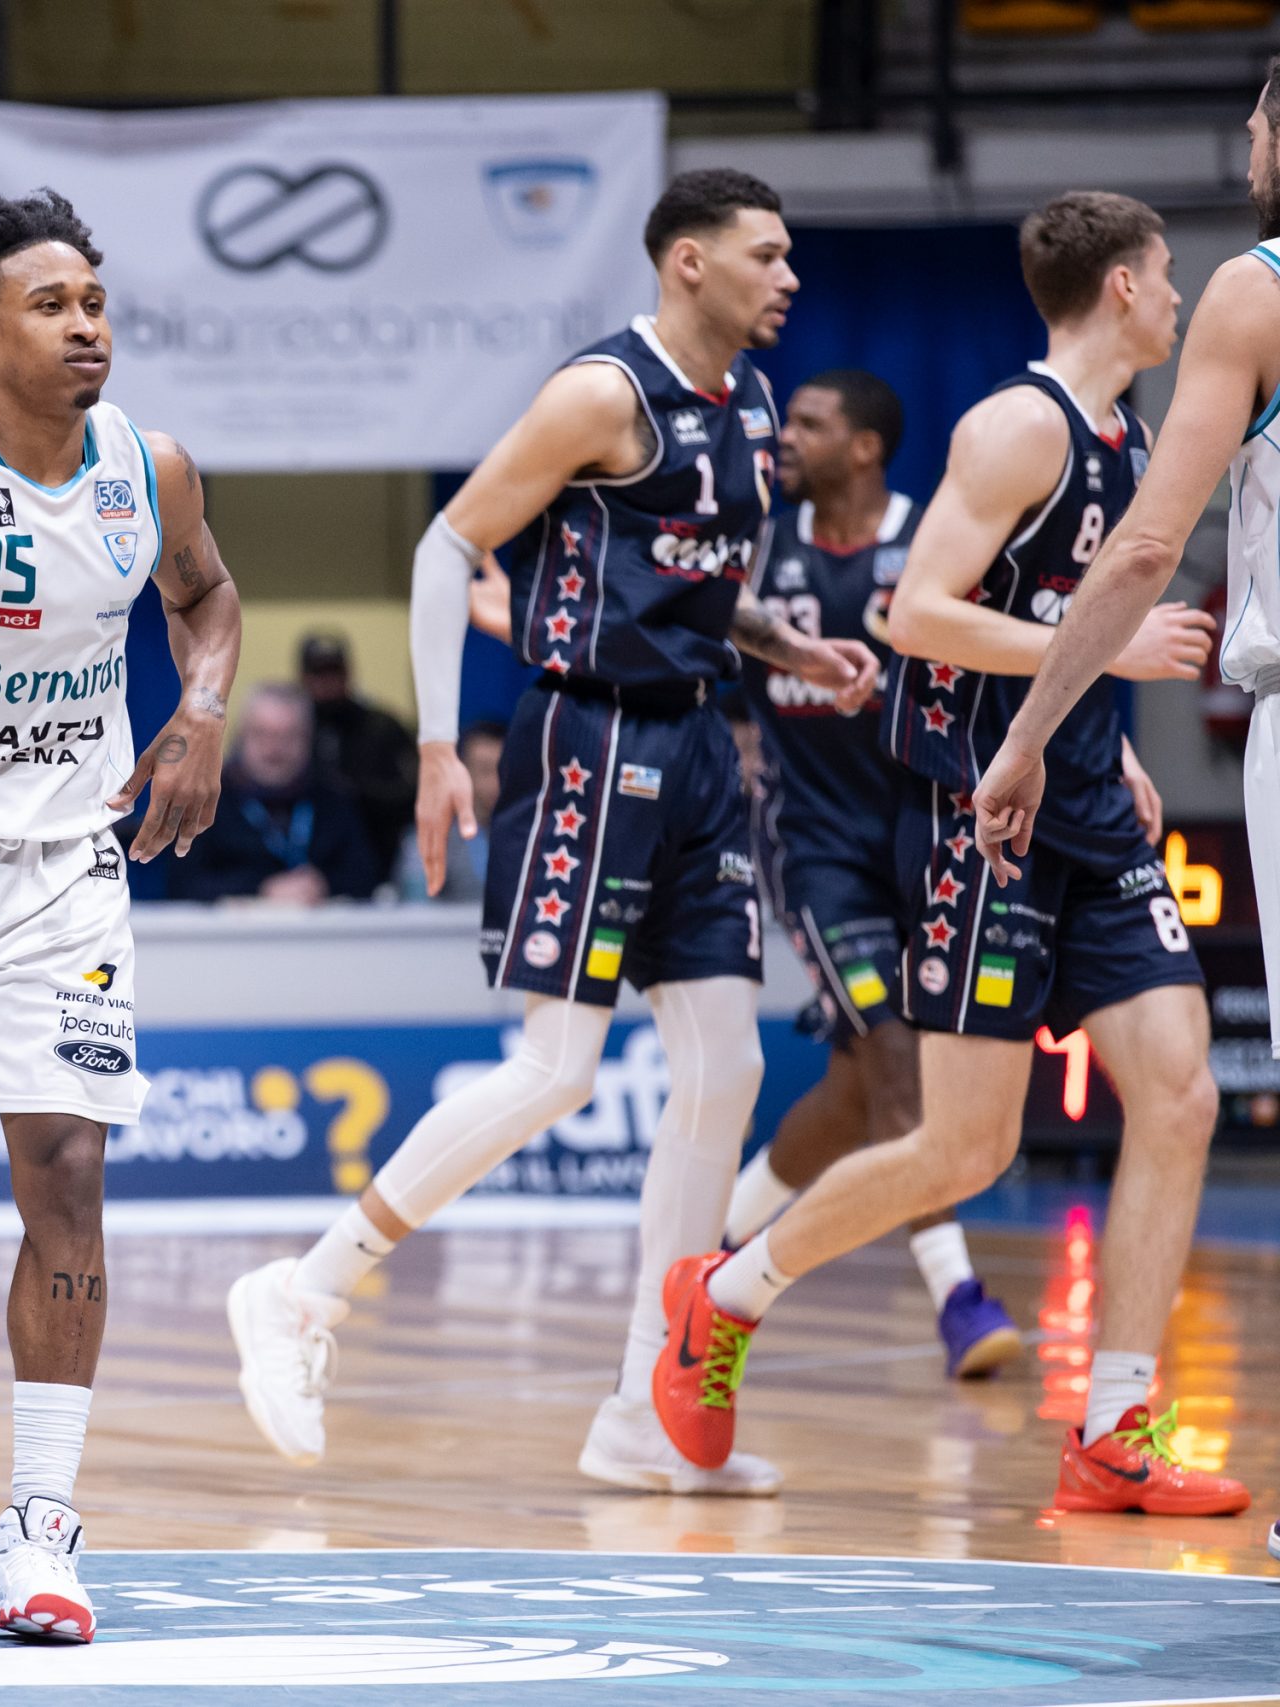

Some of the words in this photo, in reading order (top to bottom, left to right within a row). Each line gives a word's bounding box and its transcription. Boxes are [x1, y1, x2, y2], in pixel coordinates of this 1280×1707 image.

[695, 454, 718, 514] 1
[1072, 503, 1105, 563] 8
[745, 900, 760, 960] 1
[1149, 897, 1190, 952] 8
[72, 1044, 122, 1070] Ford
